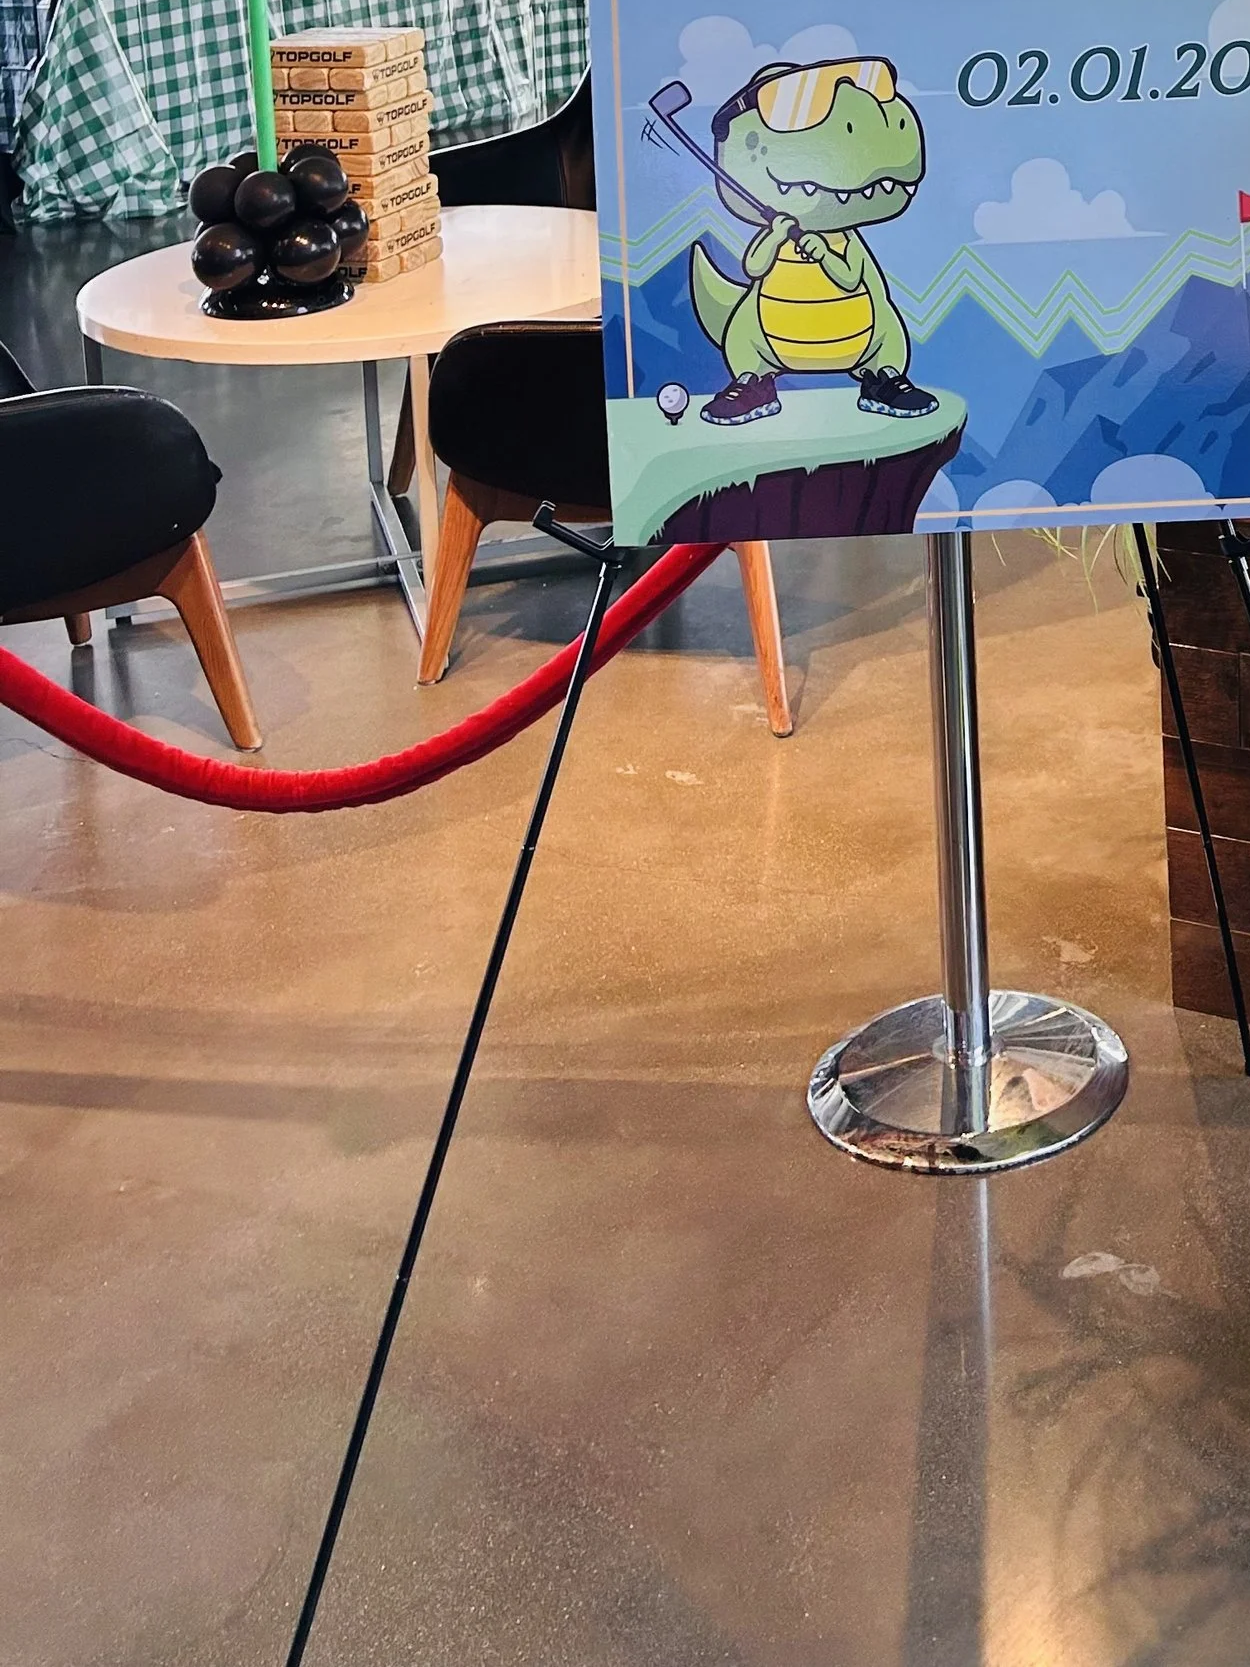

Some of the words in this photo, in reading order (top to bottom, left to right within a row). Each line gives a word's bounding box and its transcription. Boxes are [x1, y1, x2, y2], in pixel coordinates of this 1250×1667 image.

[276, 51, 352, 62] TOPGOLF
[380, 56, 419, 78] TOPGOLF
[280, 94, 355, 105] TOPGOLF
[385, 99, 427, 121] TOPGOLF
[386, 140, 424, 165] TOPGOLF
[389, 182, 432, 206] TOPGOLF
[395, 222, 436, 247] TOPGOLF
